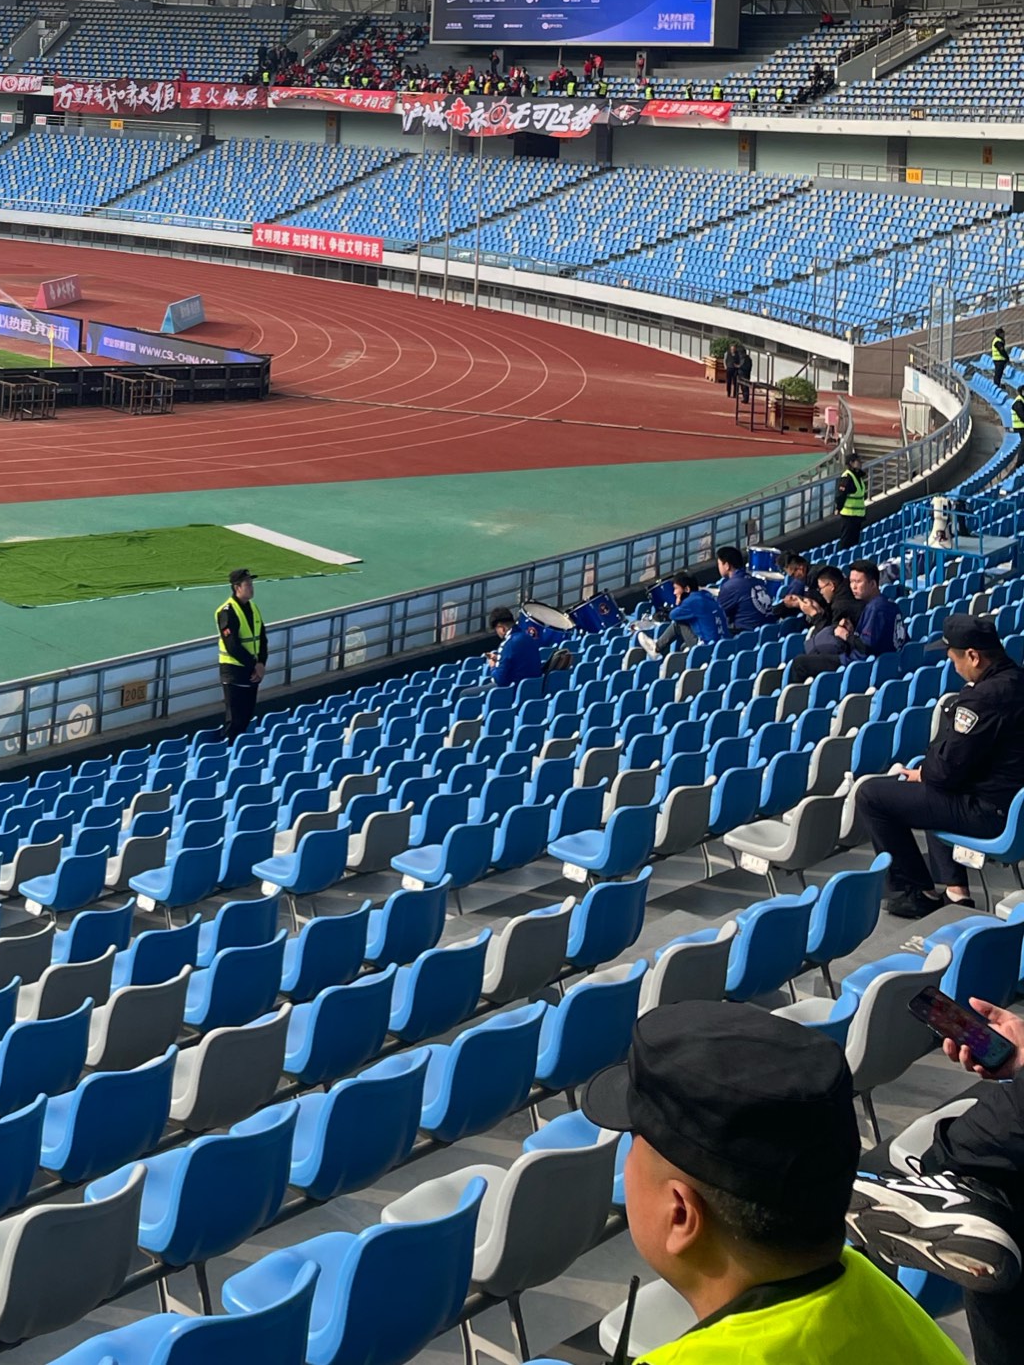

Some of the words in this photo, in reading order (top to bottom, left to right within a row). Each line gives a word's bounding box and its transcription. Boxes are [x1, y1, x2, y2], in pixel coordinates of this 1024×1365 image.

[189, 86, 258, 107] 星火燎原
[138, 344, 219, 364] WWW.CSL-CHINACOM
